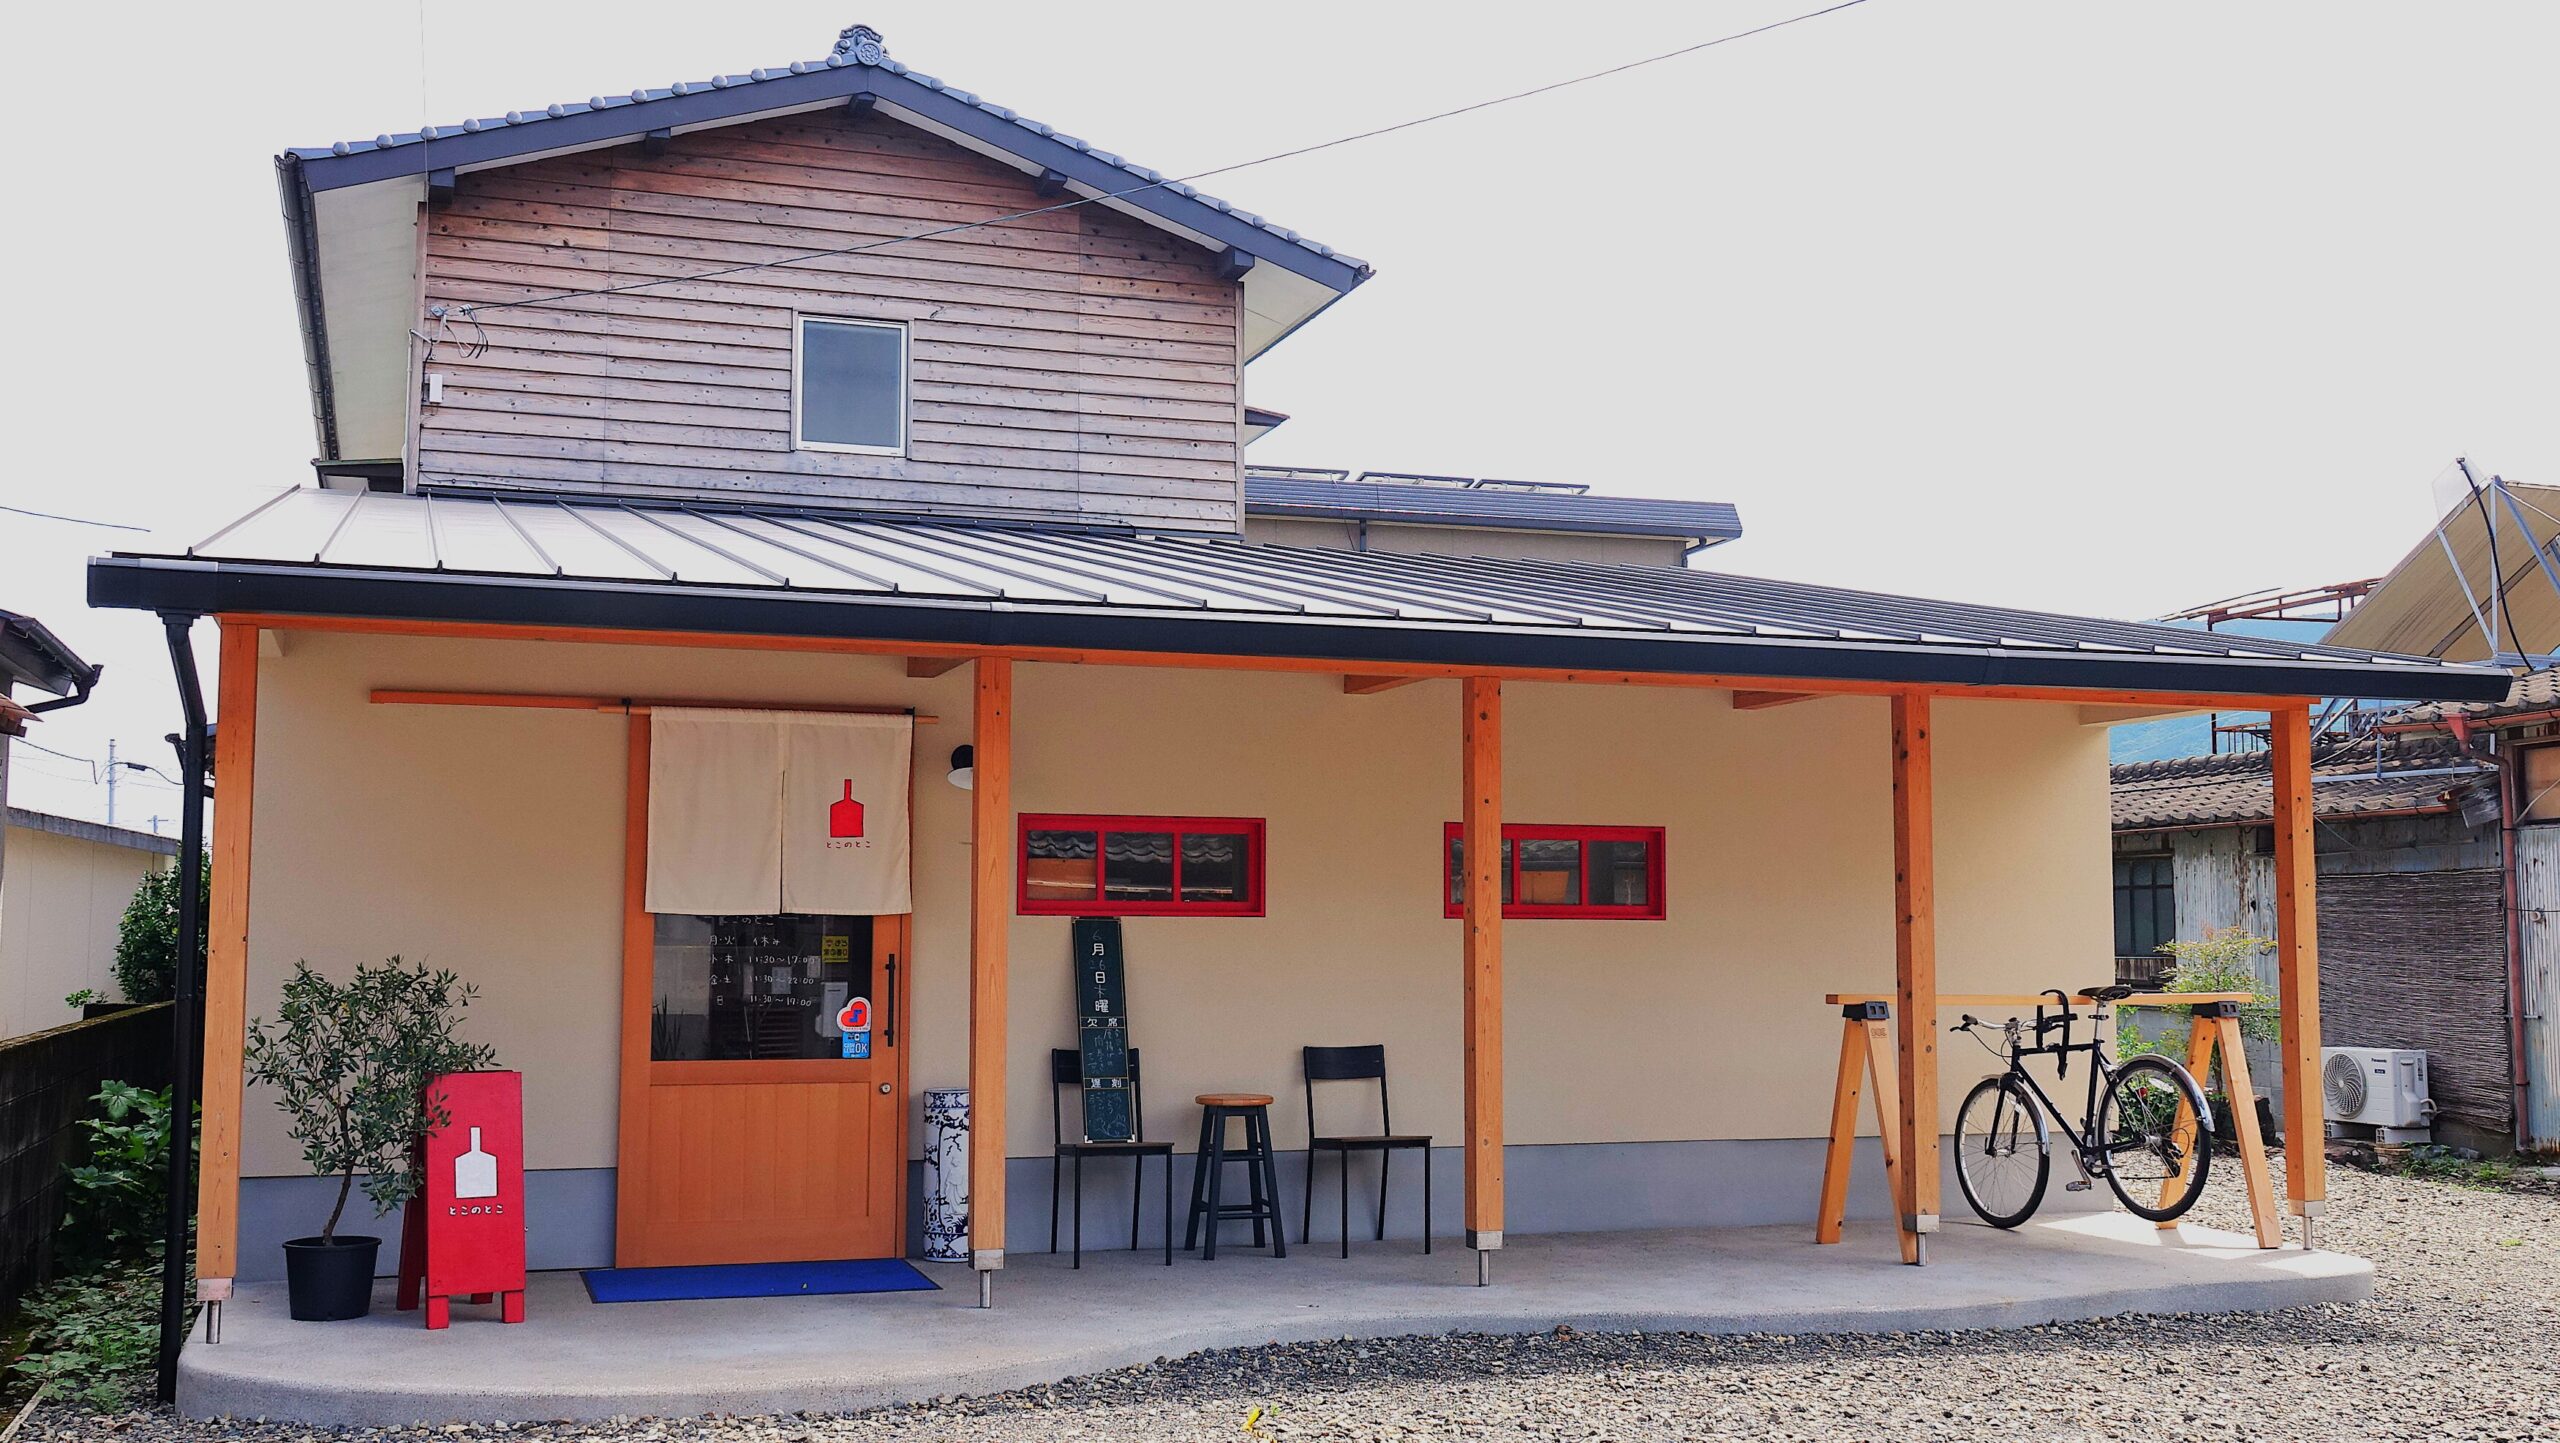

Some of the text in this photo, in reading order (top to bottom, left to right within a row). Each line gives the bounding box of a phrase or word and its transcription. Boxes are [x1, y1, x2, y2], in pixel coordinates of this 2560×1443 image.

[826, 841, 871, 849] とこのとこ
[753, 935, 780, 948] 休み
[716, 995, 724, 1006] 日
[449, 1204, 504, 1216] とこのとこ
